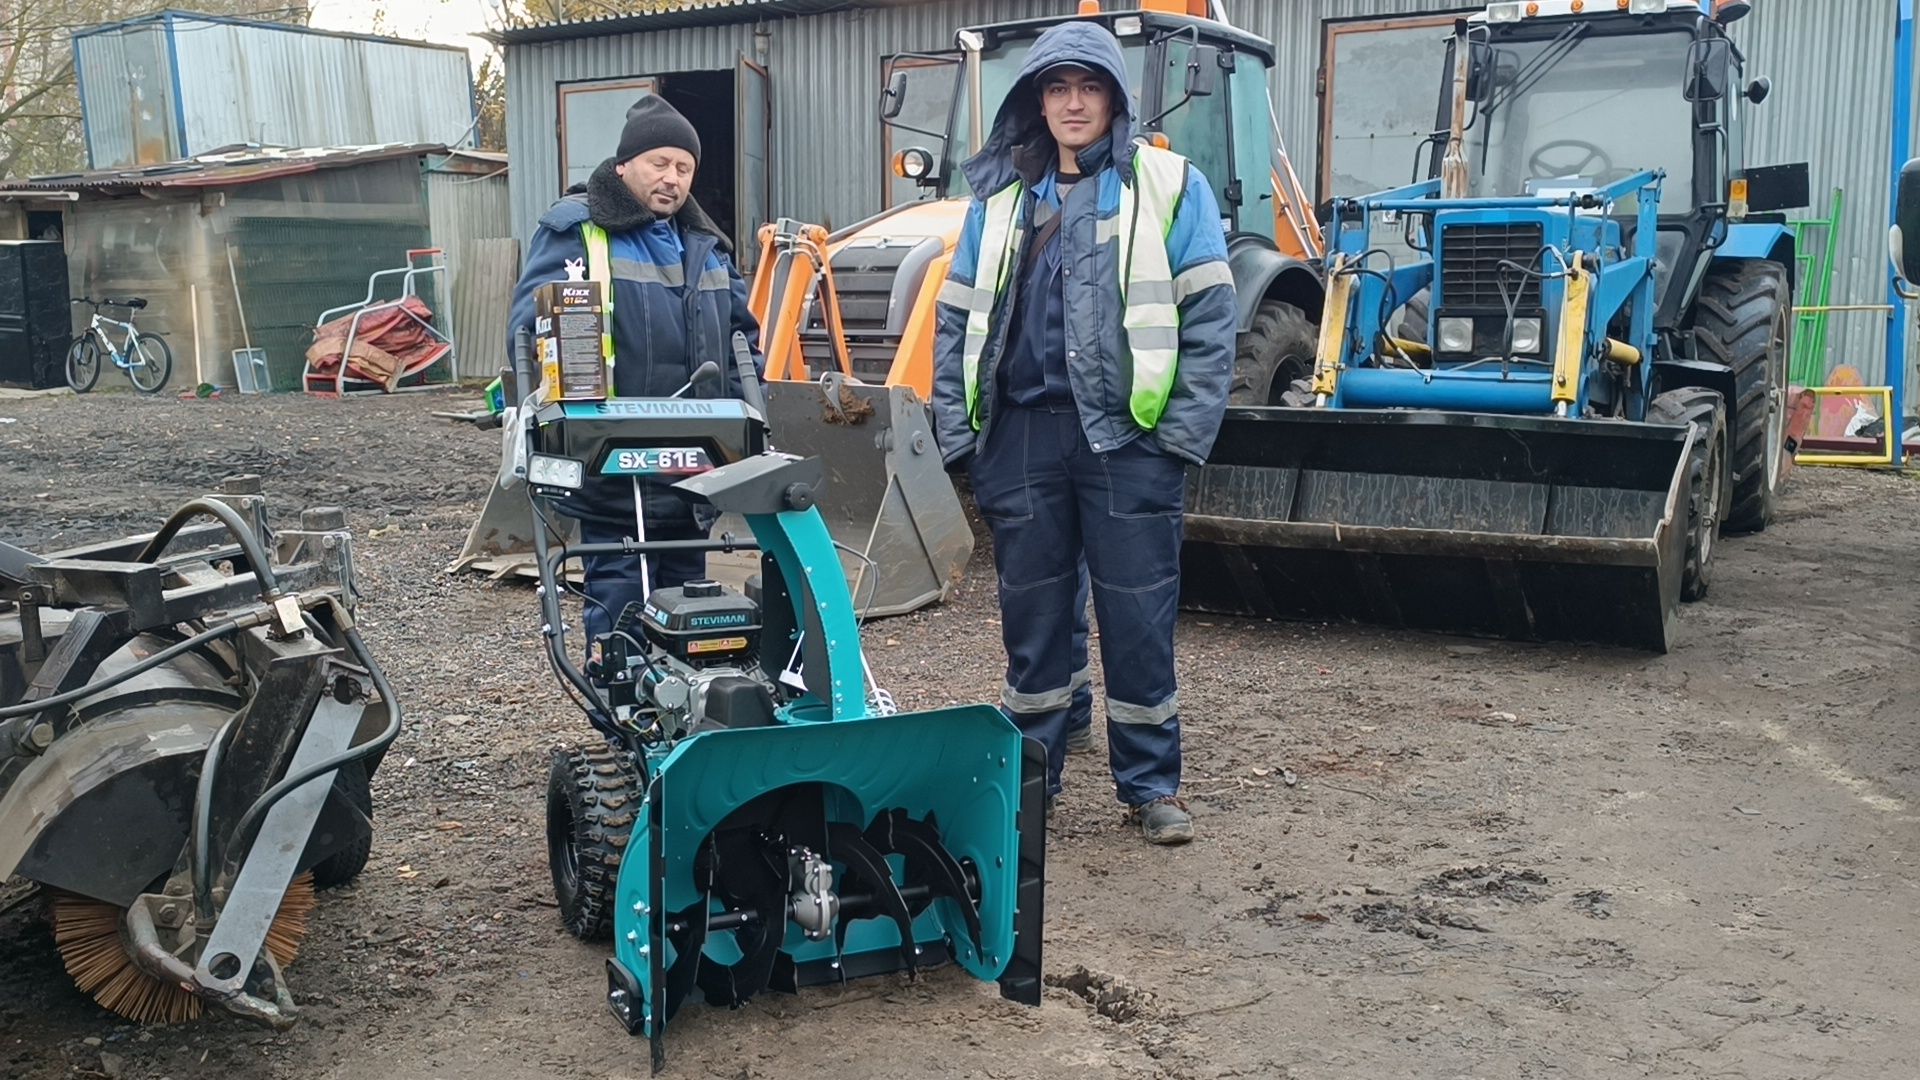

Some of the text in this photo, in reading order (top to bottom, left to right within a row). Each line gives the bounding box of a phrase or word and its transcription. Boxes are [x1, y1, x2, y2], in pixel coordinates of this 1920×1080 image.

[596, 403, 713, 414] STEVIMAN
[618, 451, 698, 468] SX-61E
[690, 614, 746, 626] STEVIMAN
